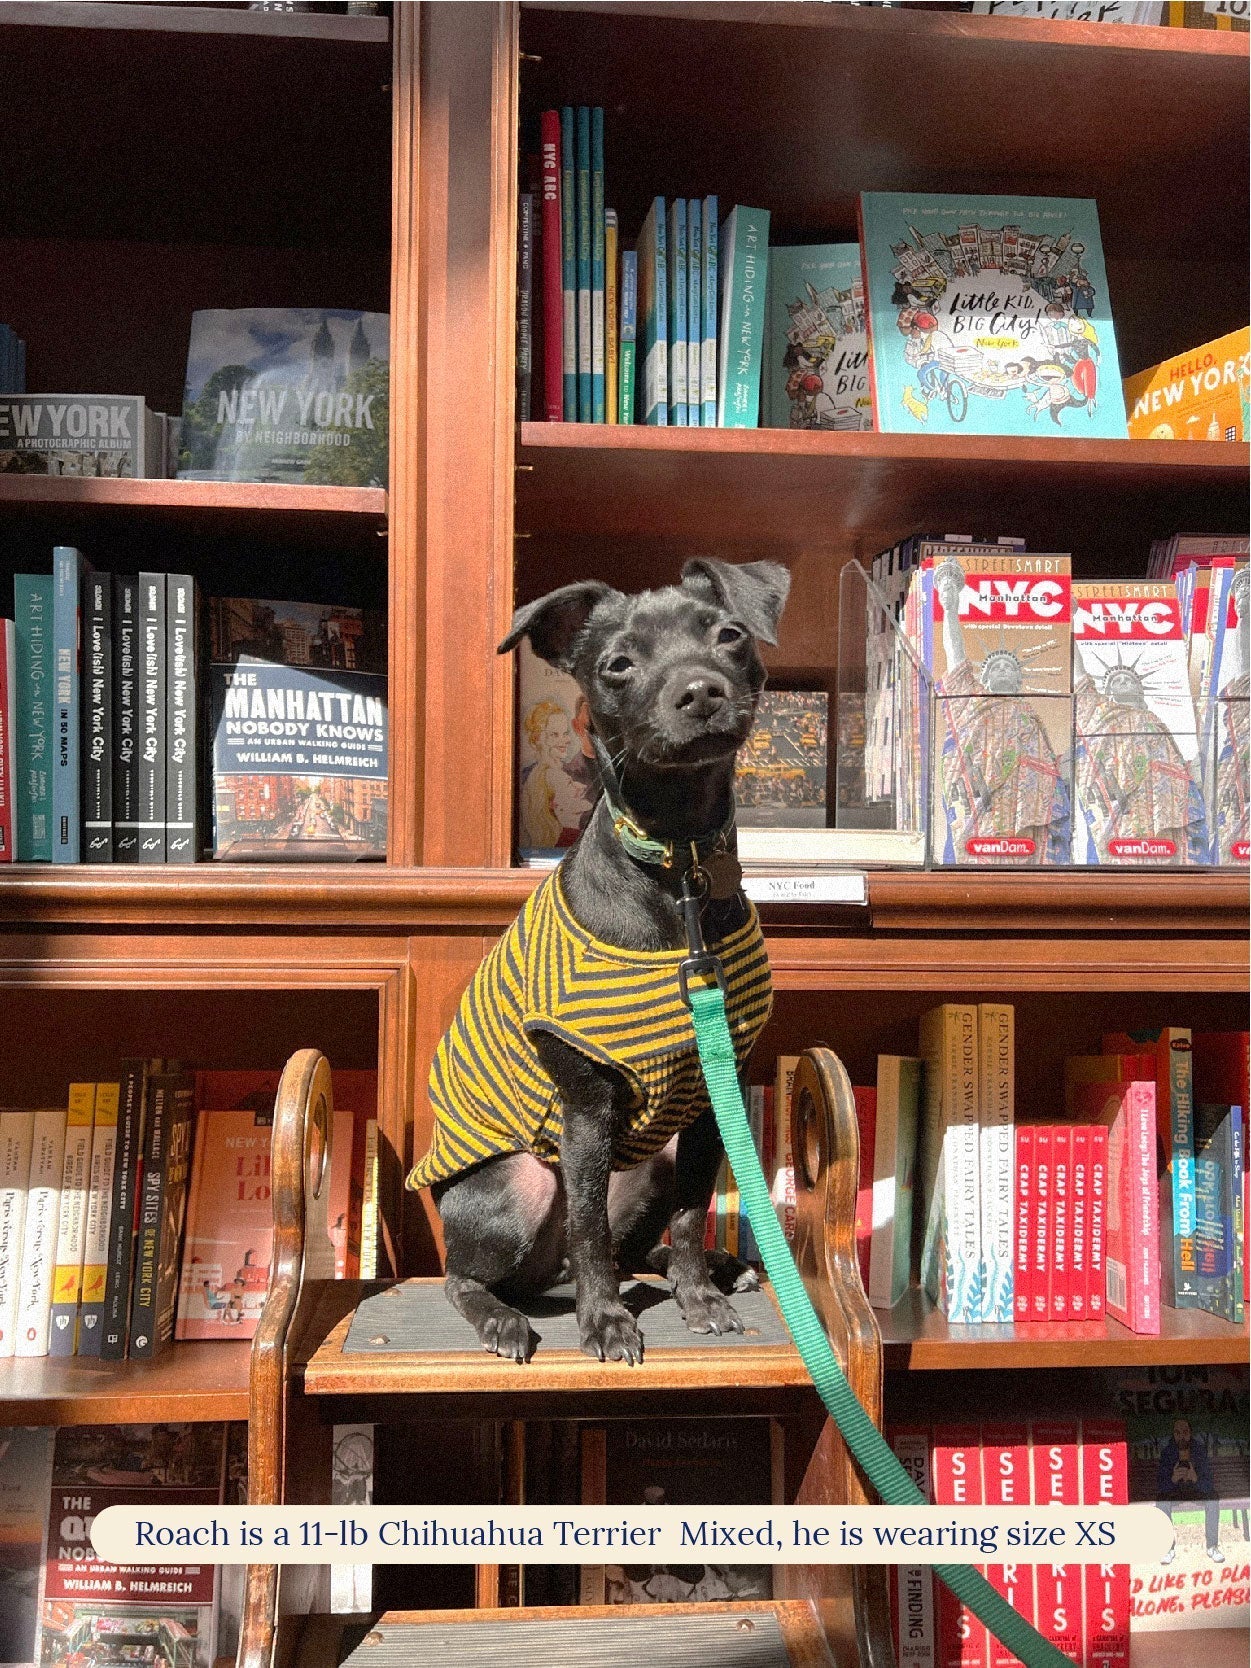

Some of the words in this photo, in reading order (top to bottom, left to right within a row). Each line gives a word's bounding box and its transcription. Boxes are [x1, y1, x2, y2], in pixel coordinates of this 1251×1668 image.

[544, 144, 556, 169] NYC
[544, 176, 557, 200] ABC
[747, 224, 757, 250] ART
[744, 254, 756, 303] HIDING
[949, 292, 1000, 315] Little
[608, 307, 616, 334] YORK,
[741, 321, 751, 346] NEW
[953, 315, 984, 334] BIG
[989, 308, 1041, 340] City!
[608, 337, 616, 364] BABY!
[976, 339, 993, 348] New
[996, 339, 1018, 349] York
[623, 350, 631, 384] Welcome
[737, 349, 751, 375] YORK
[834, 351, 868, 375] Litt
[1170, 353, 1217, 381] HELLO,
[836, 375, 866, 395] BIG
[217, 390, 288, 425] NEW
[296, 390, 375, 429] YORK
[1134, 380, 1185, 419] NEW
[0, 404, 42, 436] EW
[47, 404, 131, 438] YORK
[17, 439, 23, 447] A
[25, 439, 96, 448] PHOTOGRAPHIC
[99, 439, 131, 448] ALBUM
[236, 431, 250, 443] BY
[255, 431, 350, 446] NEIGHBORHOOD
[966, 558, 1060, 573] STREETSMART
[958, 580, 1064, 617] NYC
[979, 593, 1047, 603] Manhattan
[1078, 586, 1168, 598] STREETSMART
[29, 593, 44, 622] ART
[1073, 602, 1174, 634] NYC
[1093, 614, 1158, 622] Manhattan
[30, 626, 44, 680] HIDING
[58, 649, 71, 671] NEW
[91, 625, 104, 675] Love(ish)
[121, 627, 134, 677] Love(ish)
[145, 626, 158, 675] Love(ish)
[174, 627, 187, 677] Love(ish)
[58, 676, 72, 704] YORK
[92, 679, 104, 704] New
[121, 680, 133, 706] New
[146, 679, 157, 704] New
[174, 680, 187, 706] New
[224, 674, 257, 686] THE
[32, 701, 45, 727] NEW
[60, 709, 67, 718] IN
[92, 707, 104, 733] York
[225, 688, 383, 726] MANHATTAN
[60, 722, 68, 734] 50
[122, 708, 133, 734] York
[146, 708, 157, 734] York
[174, 708, 187, 736] York
[226, 721, 309, 736] NOBODY
[316, 724, 383, 741] KNOWS
[29, 730, 47, 761] YORK
[60, 737, 68, 767] MAPS
[90, 736, 104, 761] City
[119, 737, 133, 763] City
[143, 736, 158, 763] City
[171, 738, 186, 763] City
[298, 740, 338, 748] WALKING
[341, 742, 366, 751] GUIDE
[237, 753, 292, 763] WILLIAM
[296, 754, 308, 763] B.
[313, 754, 378, 767] HELMREICH
[769, 882, 790, 890] NYC
[793, 881, 815, 889] Food
[962, 1013, 974, 1077] GENDER
[998, 1013, 1009, 1075] GENDER
[1175, 1060, 1189, 1089] The
[155, 1089, 165, 1114] MELTON
[124, 1116, 132, 1139] GUIDE
[963, 1082, 975, 1154] SWAPPED
[998, 1082, 1009, 1153] SWAPPED
[1140, 1113, 1149, 1130] Love
[1174, 1093, 1191, 1144] Hiking
[77, 1138, 85, 1156] FIELD
[104, 1138, 112, 1156] FIELD
[123, 1141, 130, 1150] TO
[151, 1129, 162, 1159] WALLACE
[225, 1137, 257, 1148] NEW
[76, 1157, 84, 1176] GUIDE
[103, 1157, 111, 1176] GUIDE
[1141, 1153, 1150, 1167] The
[1177, 1149, 1194, 1188] Book
[75, 1177, 83, 1186] TO
[103, 1177, 110, 1186] TO
[120, 1170, 128, 1190] YORK
[146, 1172, 161, 1191] SPY
[963, 1159, 975, 1205] FAIRY
[998, 1158, 1009, 1204] FAIRY
[1020, 1164, 1029, 1196] CRAP
[1038, 1164, 1047, 1196] CRAP
[1056, 1164, 1065, 1196] CRAP
[1075, 1164, 1084, 1196] CRAP
[1093, 1164, 1102, 1196] CRAP
[1139, 1168, 1150, 1185] Joys
[74, 1188, 82, 1199] THE
[101, 1188, 109, 1199] THE
[144, 1195, 160, 1223] SITES
[1140, 1196, 1151, 1236] Friendship
[1178, 1193, 1195, 1236] From
[70, 1200, 82, 1252] NEIGHBORHOOD
[98, 1200, 108, 1252] NEIGHBORHOOD
[146, 1229, 156, 1237] OF
[964, 1210, 976, 1259] TALES
[998, 1210, 1009, 1258] TALES
[1018, 1200, 1028, 1271] TAXIDERMY
[1036, 1200, 1046, 1271] TAXIDERMY
[1055, 1200, 1065, 1271] TAXIDERMY
[1074, 1200, 1083, 1271] TAXIDERMY
[1092, 1200, 1102, 1271] TAXIDERMY
[143, 1239, 155, 1258] NEW
[1180, 1238, 1195, 1271] Hell
[141, 1261, 154, 1284] YORK
[139, 1288, 151, 1307] CITY
[63, 1497, 91, 1510] THE
[120, 1566, 155, 1574] WALKING
[159, 1567, 182, 1575] GUIDE
[1148, 1573, 1187, 1593] LIKE
[1191, 1570, 1213, 1587] TO
[1221, 1564, 1250, 1583] PLA
[63, 1579, 112, 1590] WILLIAM
[115, 1581, 126, 1591] B.
[130, 1581, 192, 1593] HELMREICH
[1190, 1587, 1250, 1610] PLEAS
[908, 1579, 923, 1638] FINDING
